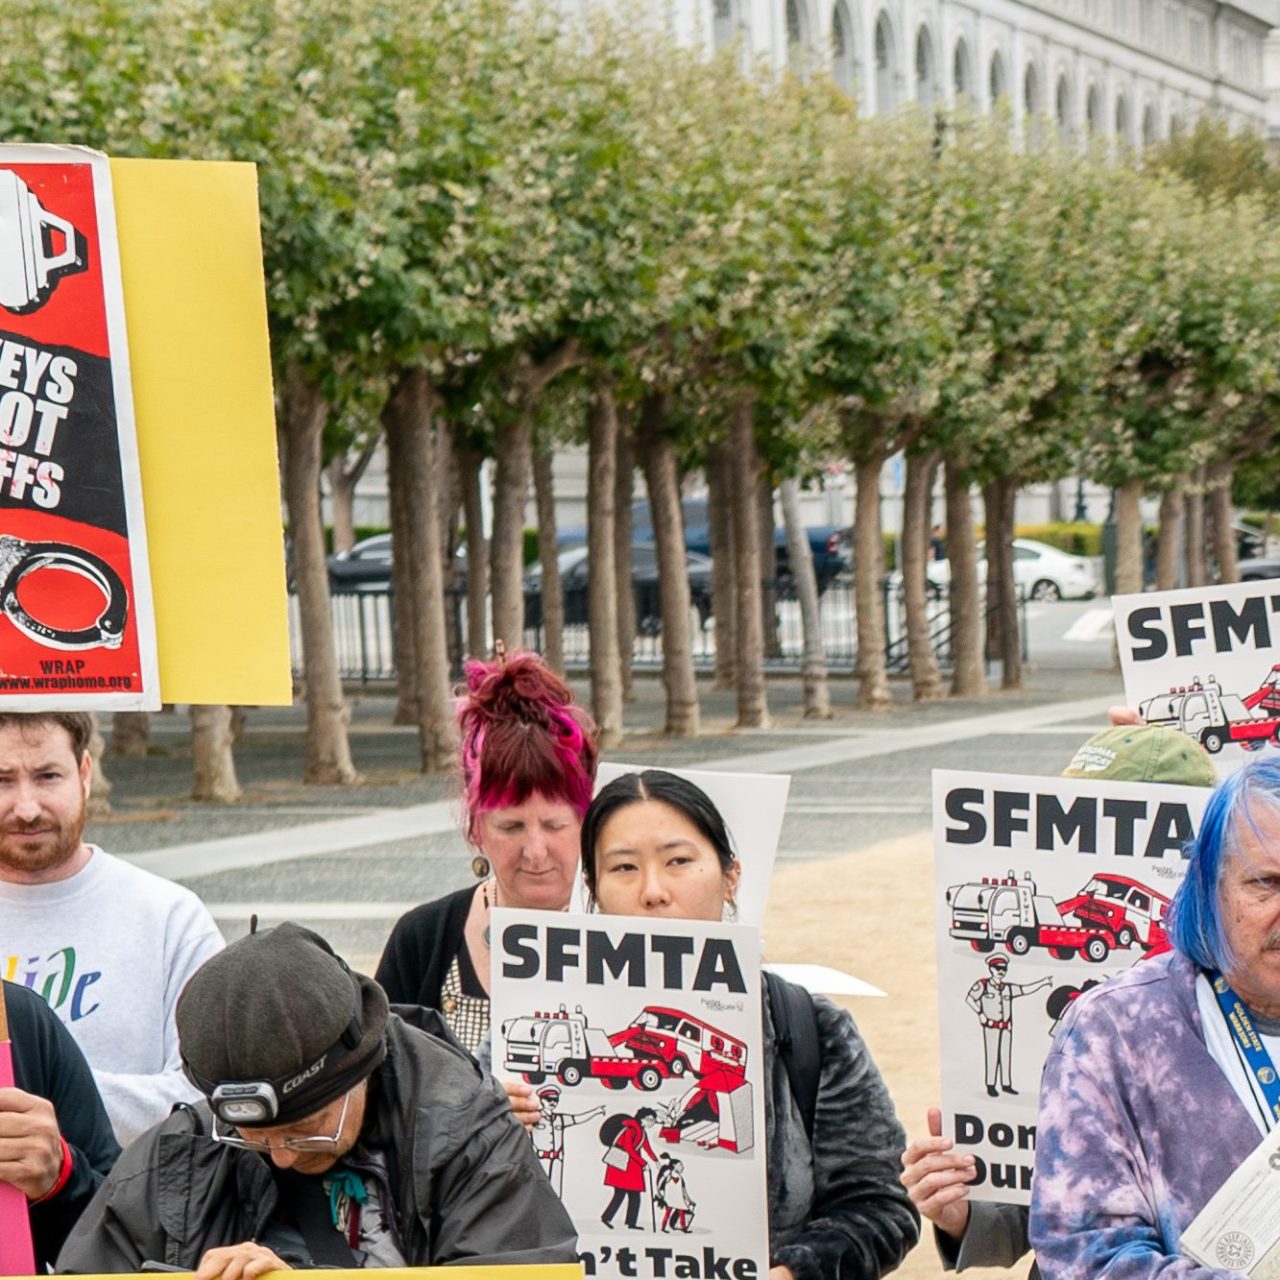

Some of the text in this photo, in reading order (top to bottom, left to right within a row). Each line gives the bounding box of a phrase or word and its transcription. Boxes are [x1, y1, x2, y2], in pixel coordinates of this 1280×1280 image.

[0, 338, 78, 404] EYS
[39, 660, 86, 675] WRAP
[945, 787, 1196, 860] SFMTA
[502, 923, 748, 994] SFMTA
[283, 1053, 328, 1094] COAST
